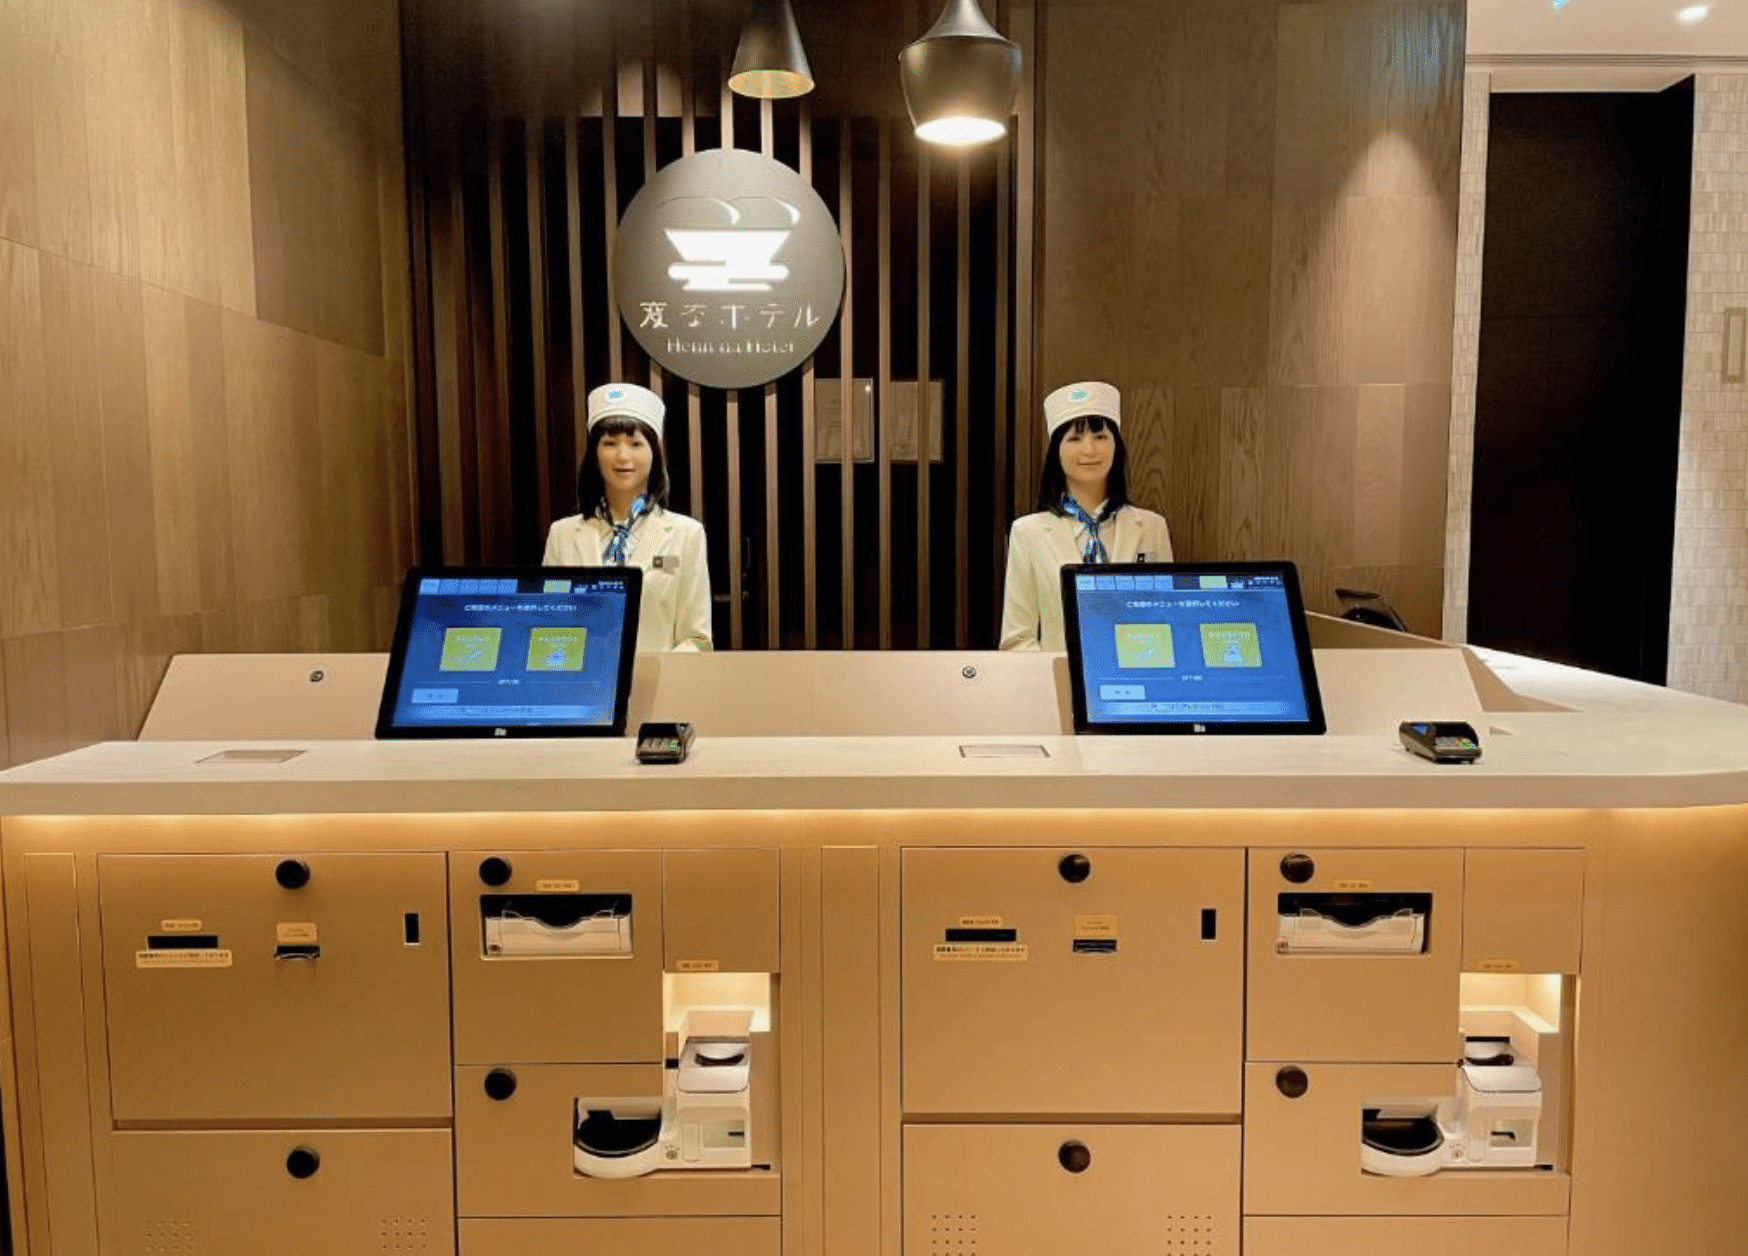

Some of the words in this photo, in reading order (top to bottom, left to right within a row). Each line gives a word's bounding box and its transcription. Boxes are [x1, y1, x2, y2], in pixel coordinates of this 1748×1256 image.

[640, 301, 821, 331] 変なホテル
